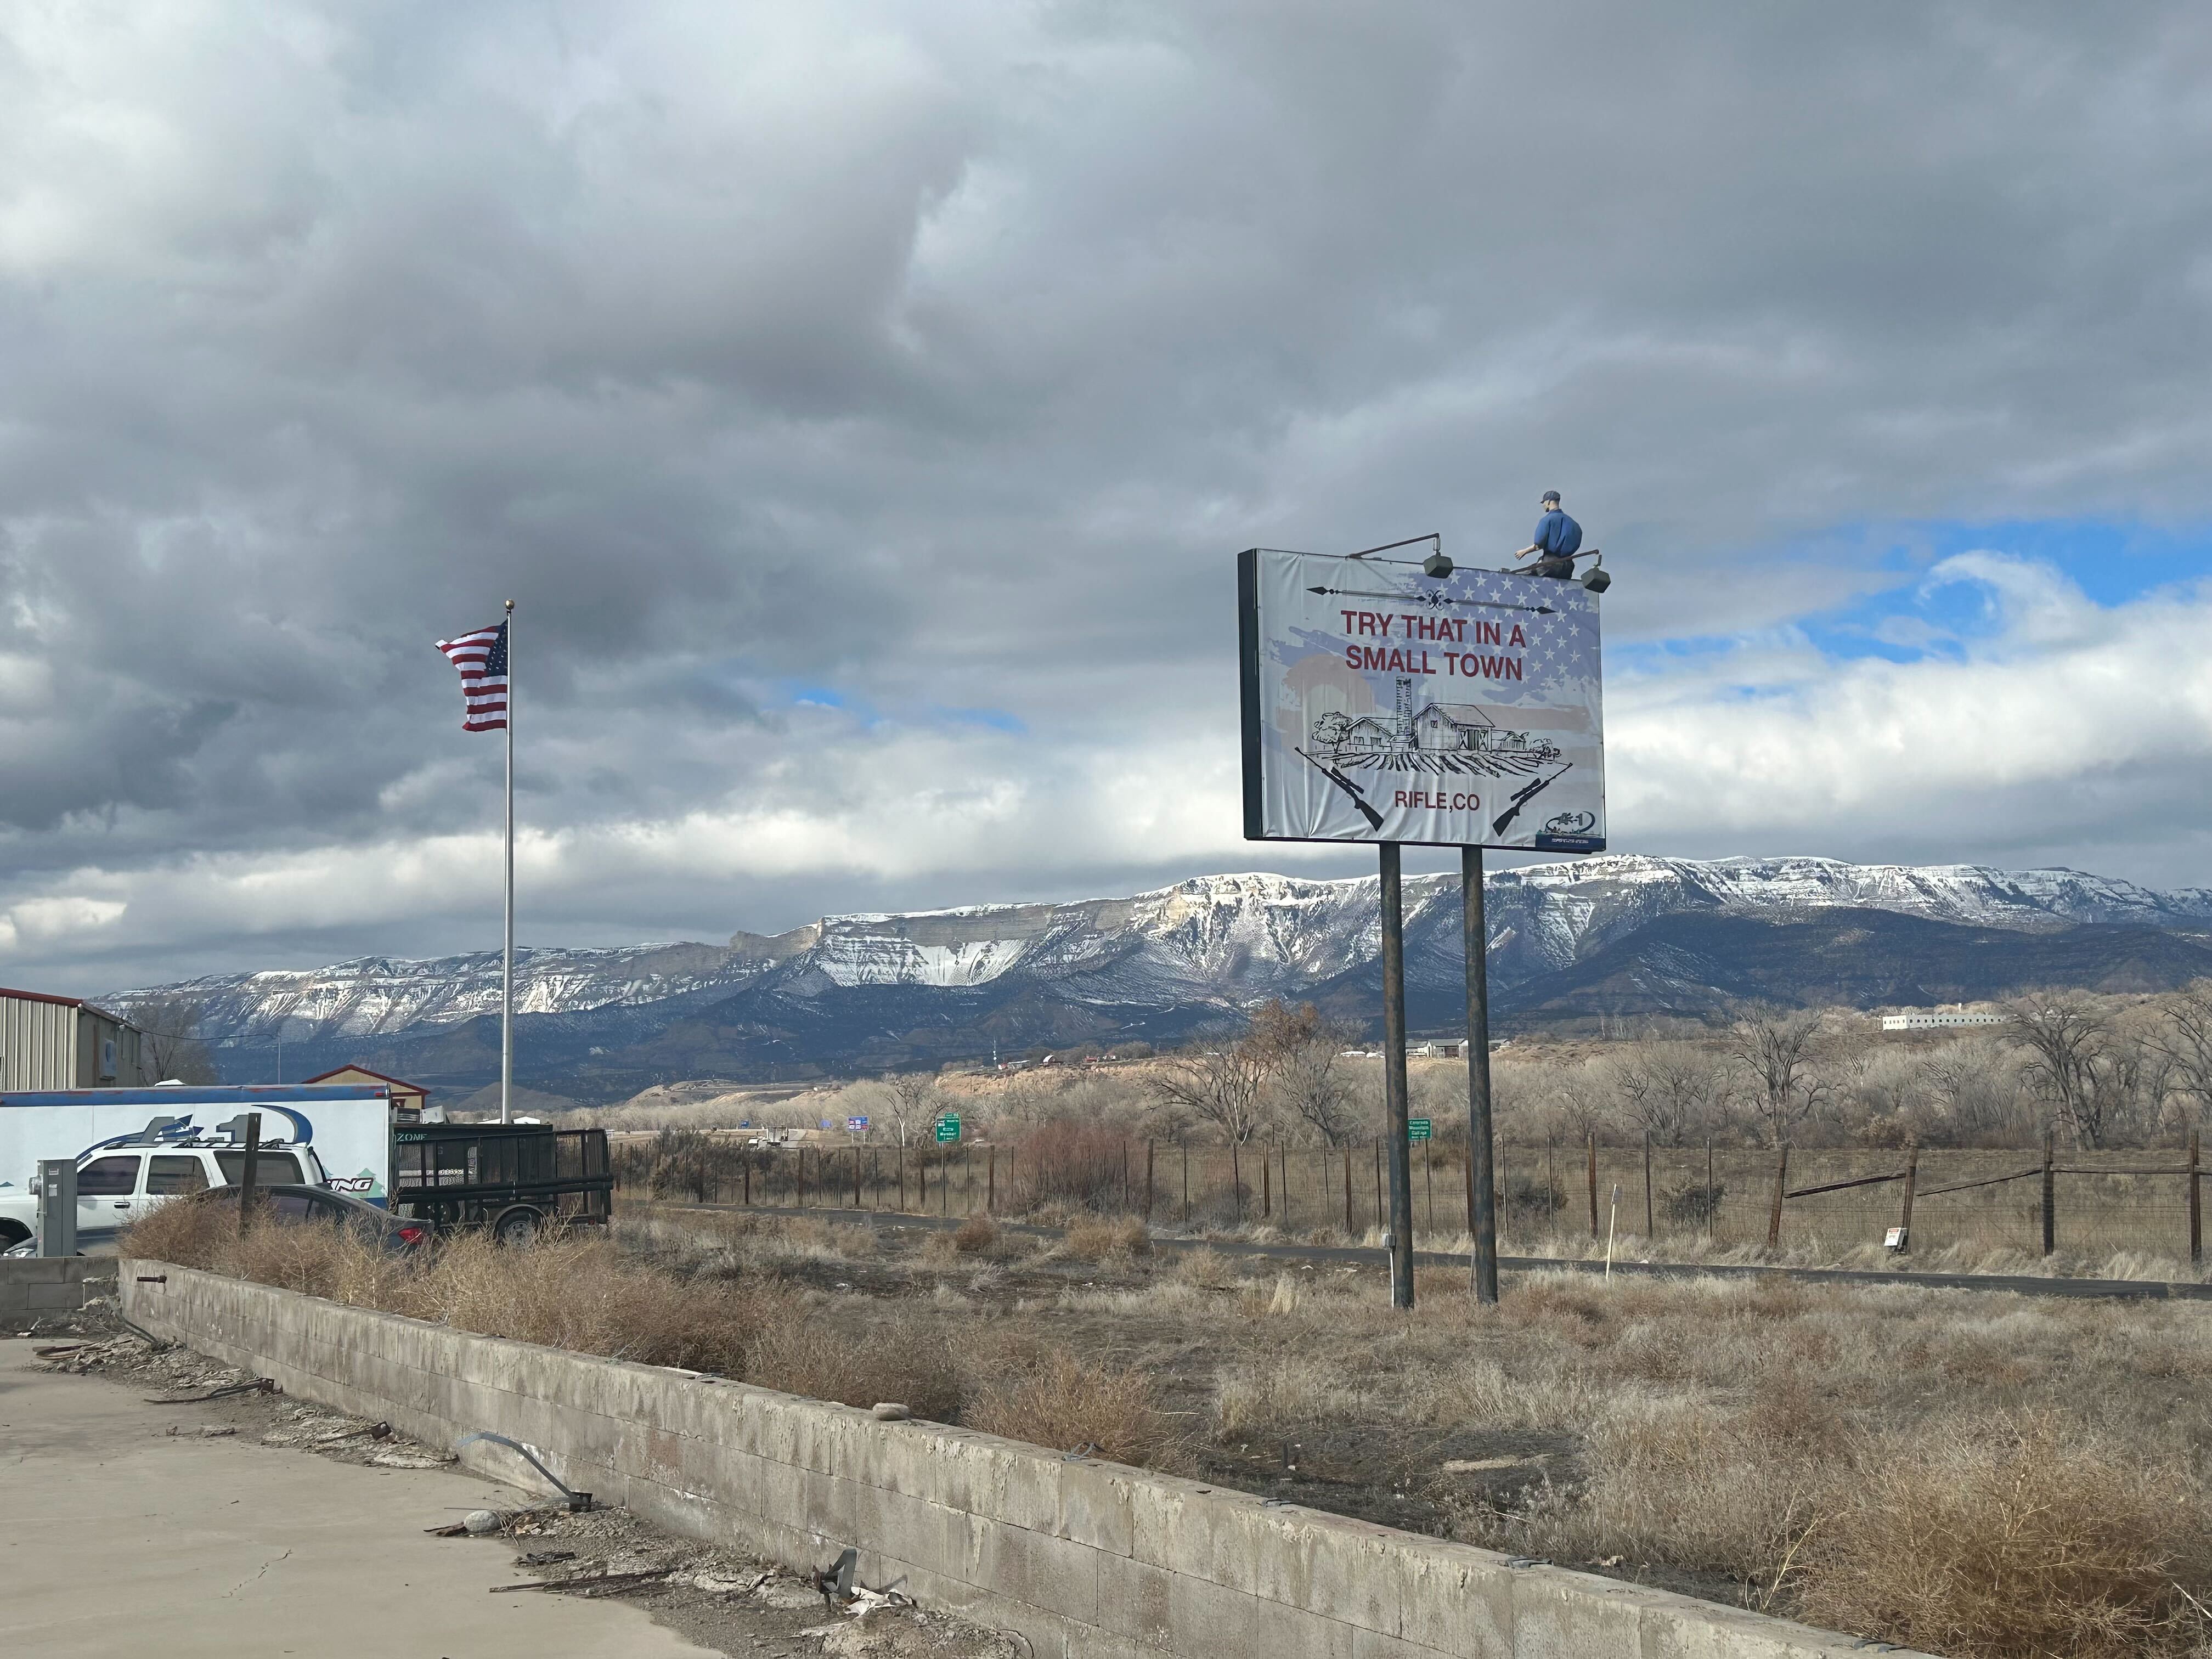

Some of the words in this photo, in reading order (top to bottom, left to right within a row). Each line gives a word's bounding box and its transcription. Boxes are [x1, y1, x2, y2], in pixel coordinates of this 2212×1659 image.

[1341, 610, 1393, 636] TRY
[1401, 614, 1468, 642] THAT
[1476, 621, 1500, 646] IN
[1509, 624, 1526, 648] A
[1346, 645, 1436, 674] SMALL
[1444, 652, 1522, 681] TOWN
[1395, 791, 1480, 813] RIFLE,CO
